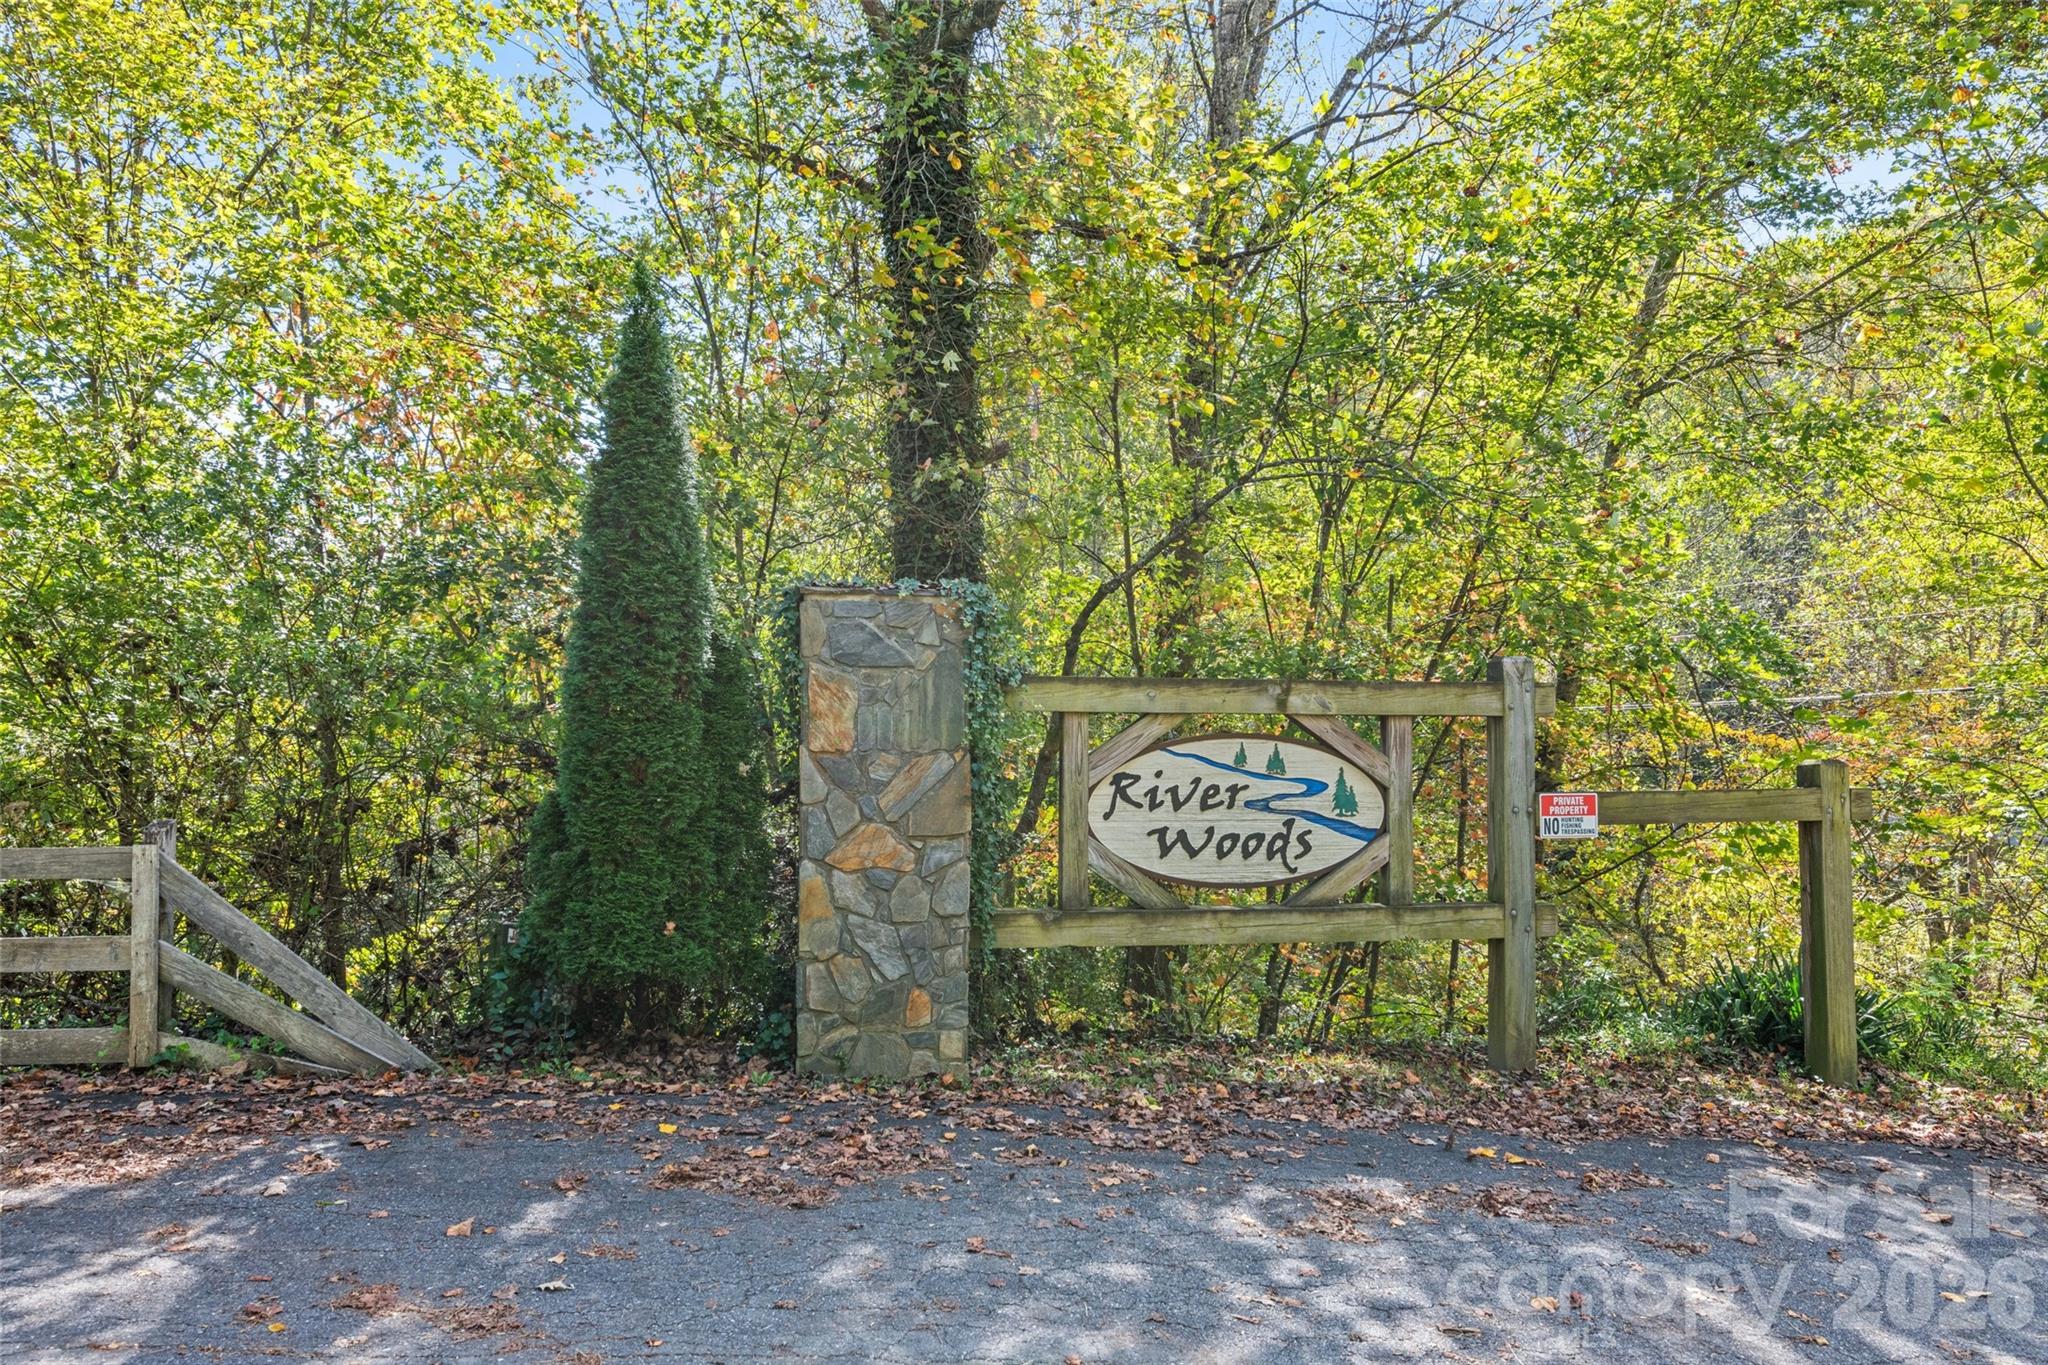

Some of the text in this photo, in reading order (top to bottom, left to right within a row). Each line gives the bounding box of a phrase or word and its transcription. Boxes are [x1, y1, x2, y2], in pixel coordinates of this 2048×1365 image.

[1102, 769, 1250, 821] River
[1553, 796, 1584, 805] PRIVATE
[1549, 806, 1588, 815] PROPERTY
[1543, 817, 1560, 835] NO
[1146, 817, 1313, 874] Woods
